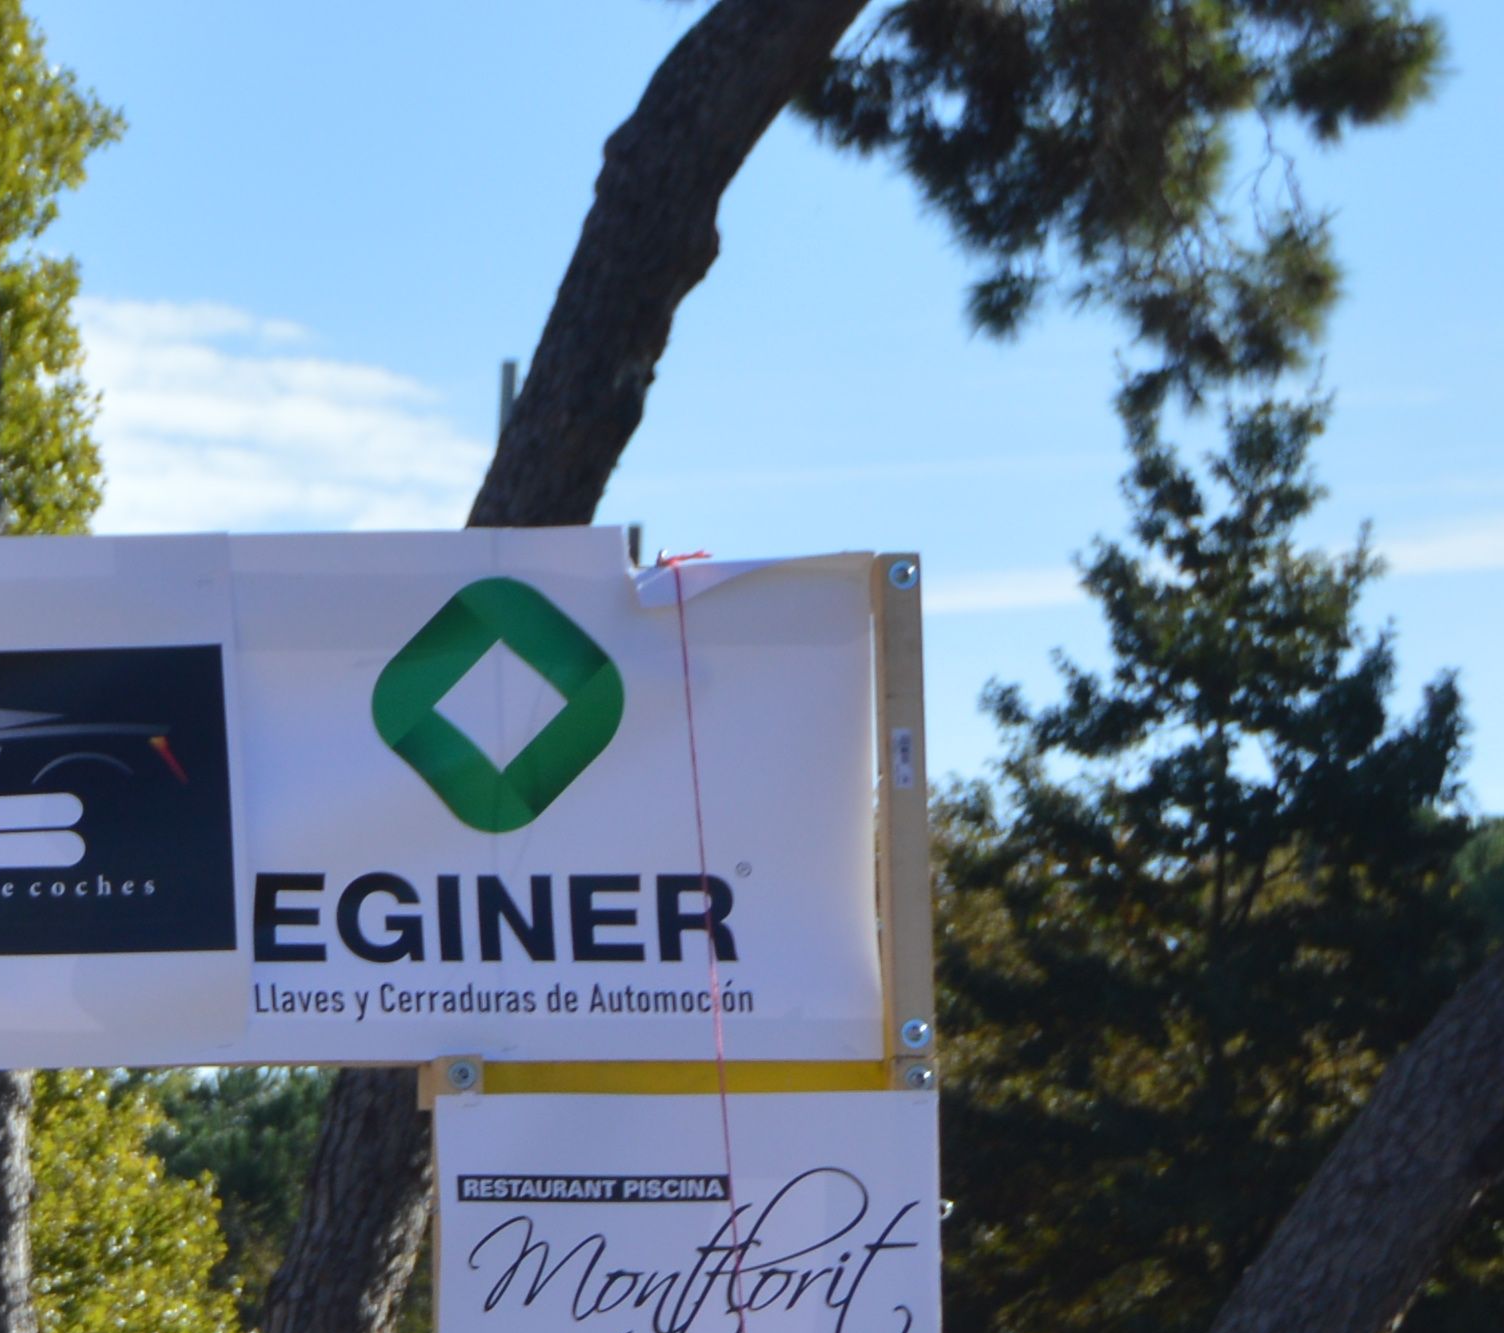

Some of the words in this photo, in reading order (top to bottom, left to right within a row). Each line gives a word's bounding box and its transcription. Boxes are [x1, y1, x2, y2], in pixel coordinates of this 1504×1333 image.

[28, 874, 157, 897] coches
[252, 871, 738, 963] EGINER
[253, 983, 345, 1014] Llaves
[354, 988, 370, 1022] y
[378, 983, 537, 1014] Cerraduras
[547, 983, 579, 1014] de
[589, 978, 755, 1014] Automocón
[463, 1179, 617, 1199] RESTAURANT
[622, 1178, 726, 1199] PISCINA
